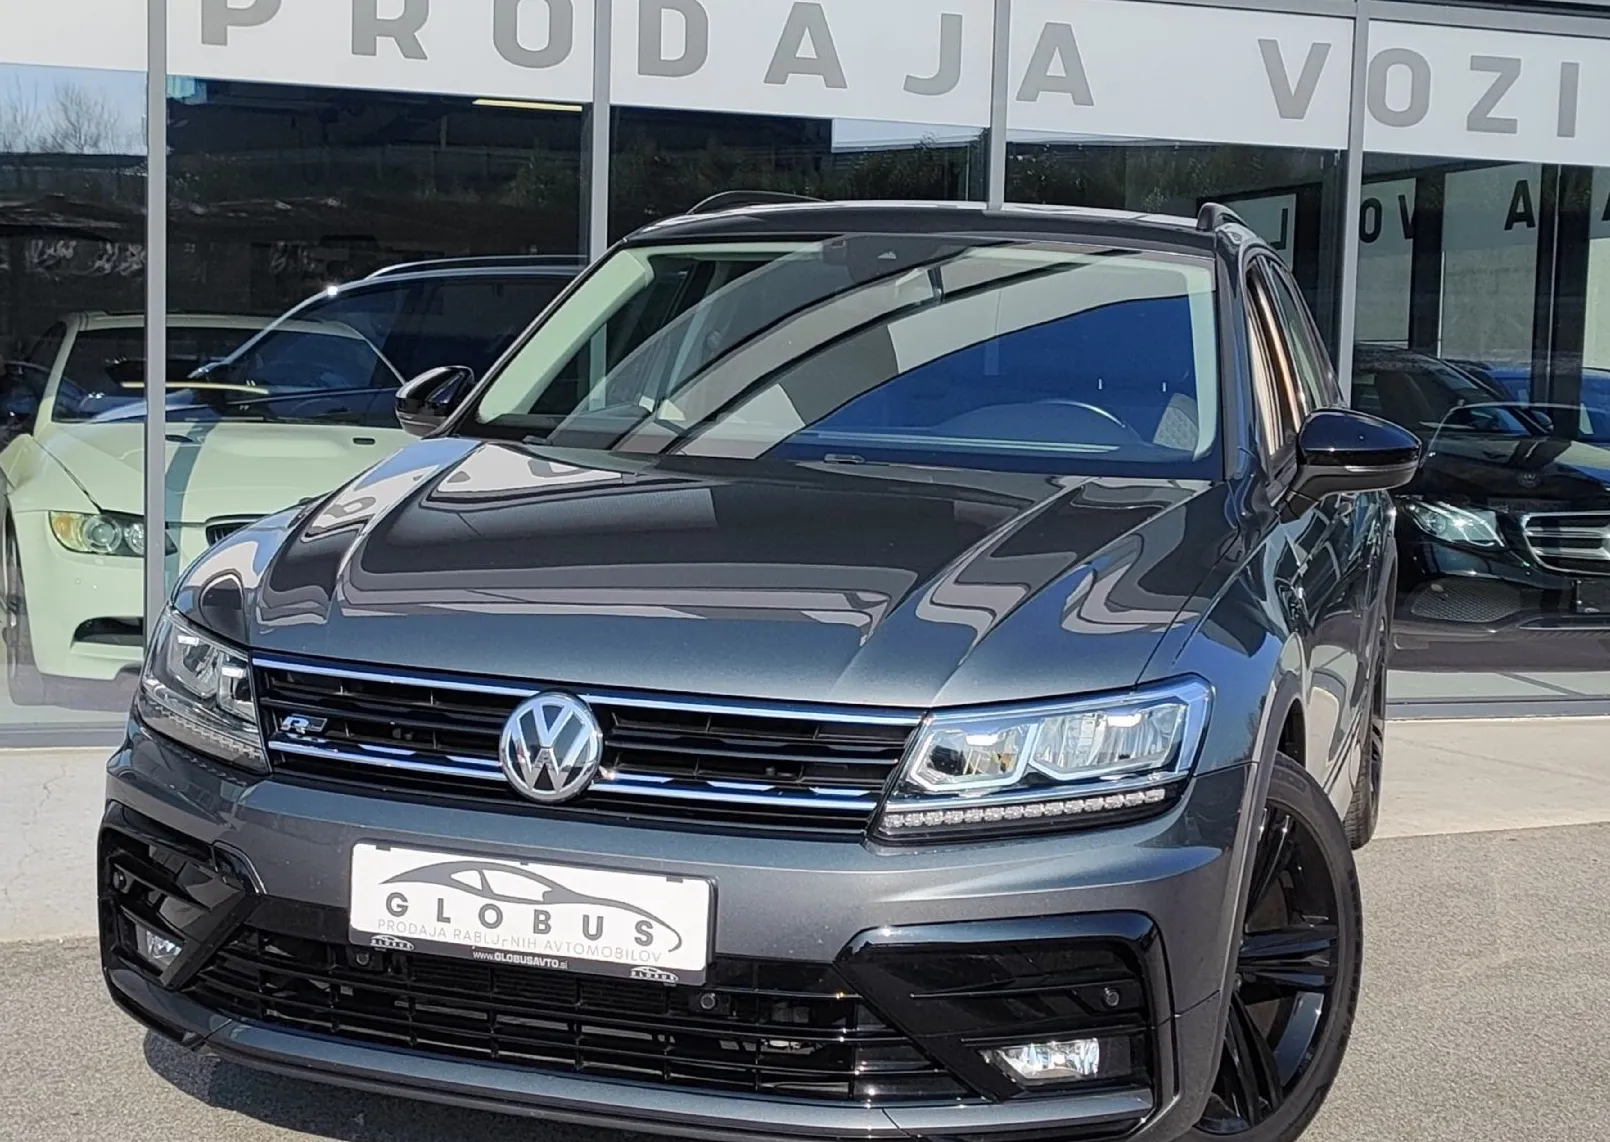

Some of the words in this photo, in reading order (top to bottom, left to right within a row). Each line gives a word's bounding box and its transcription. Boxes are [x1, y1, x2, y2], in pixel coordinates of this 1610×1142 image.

[377, 919, 447, 939] PRODAJA
[544, 940, 662, 963] AVTOMOBILOV
[385, 892, 655, 946] GLOBUS
[472, 951, 568, 969] www.GLOBUSAVTO.si
